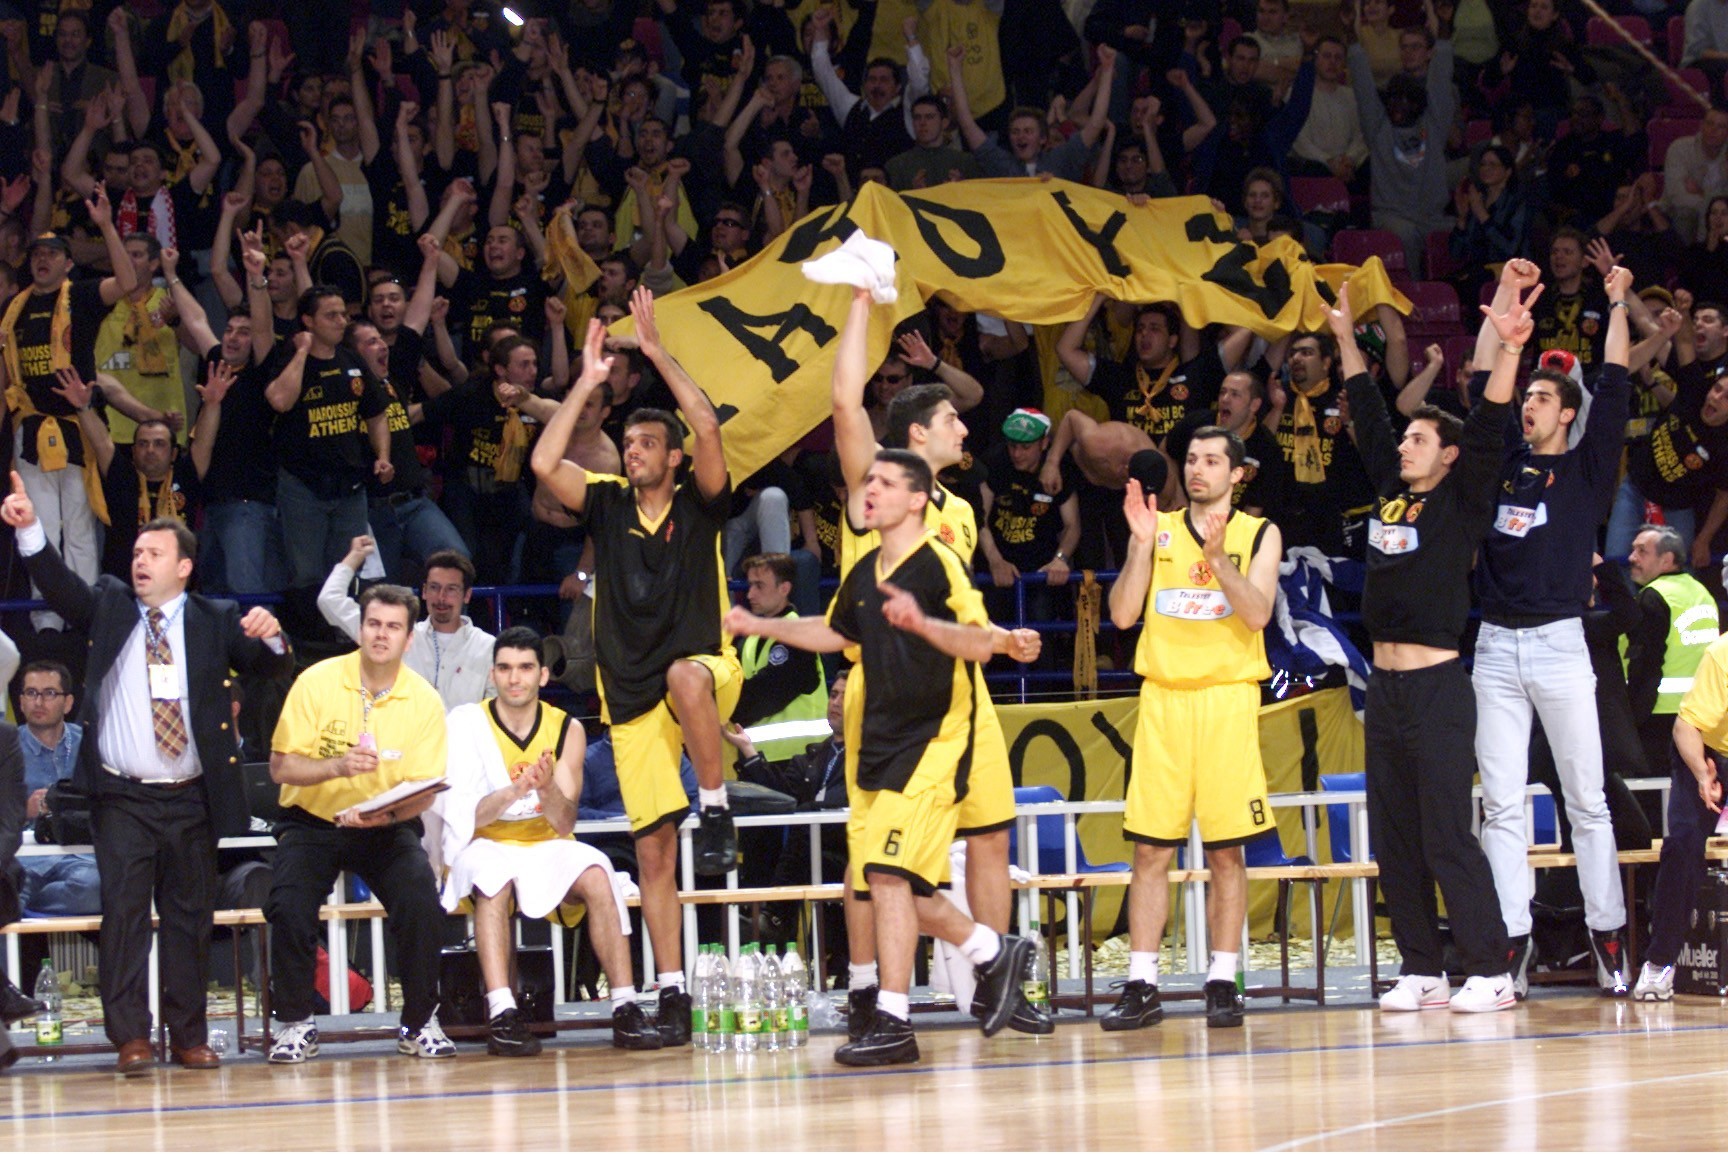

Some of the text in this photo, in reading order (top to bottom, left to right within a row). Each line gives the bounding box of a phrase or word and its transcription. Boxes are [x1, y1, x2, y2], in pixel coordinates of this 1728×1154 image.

[1250, 798, 1266, 826] 8
[884, 829, 902, 856] 6
[1676, 942, 1718, 968] Mueller
